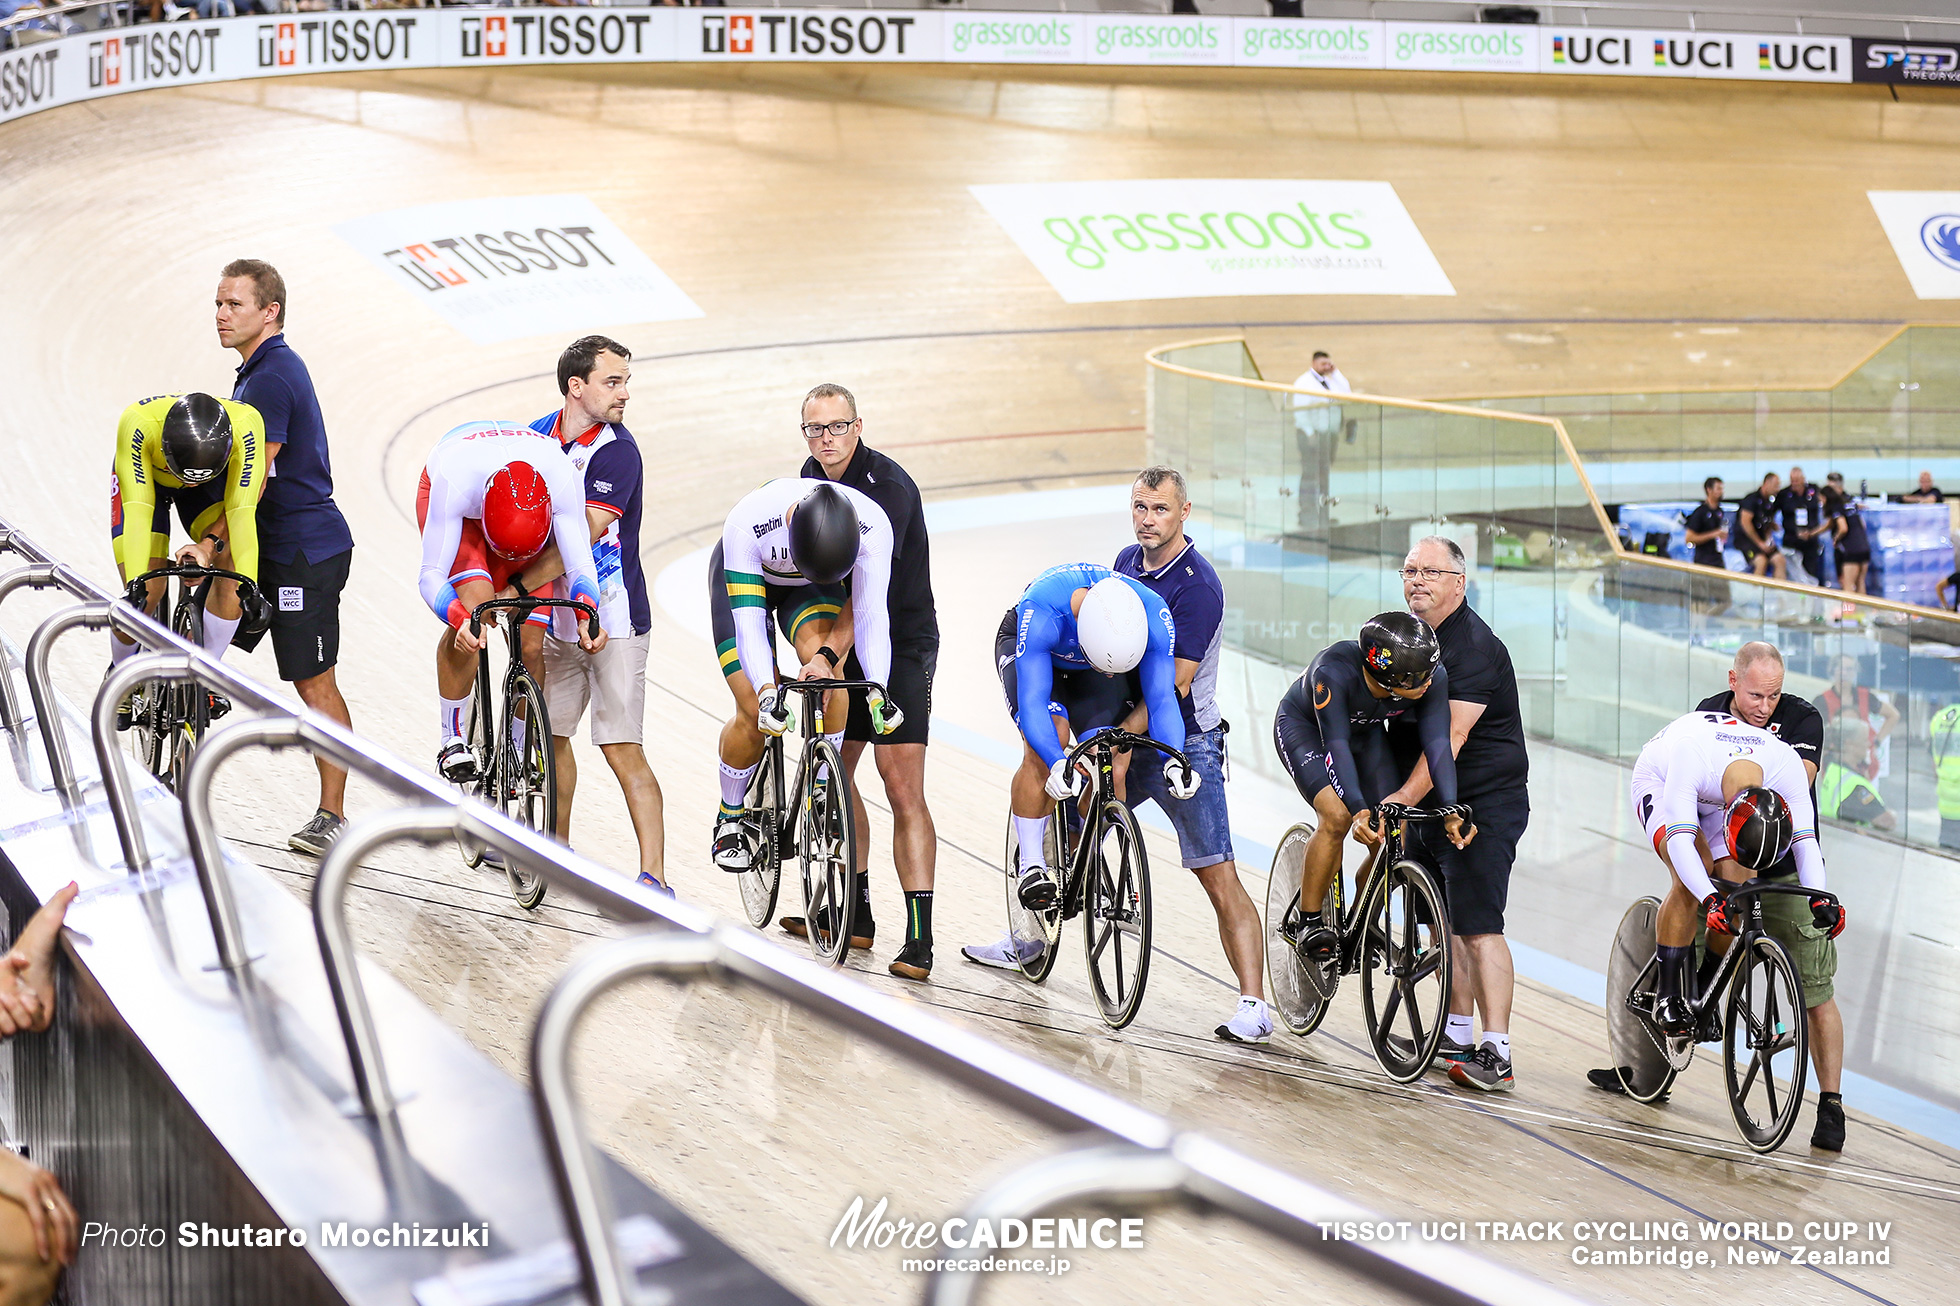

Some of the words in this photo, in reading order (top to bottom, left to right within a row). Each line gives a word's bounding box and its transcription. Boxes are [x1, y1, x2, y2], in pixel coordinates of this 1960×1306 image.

[301, 18, 416, 64] TISSOT
[513, 15, 650, 55] TISSOT
[760, 16, 914, 54] TISSOT
[953, 18, 1071, 53] grassroots
[1096, 22, 1218, 55] grassroots
[1244, 25, 1369, 57] grassroots
[1396, 30, 1523, 61] grassroots
[1568, 38, 1631, 66] UCI
[125, 28, 221, 83] TISSOT
[1669, 41, 1734, 69] UCI
[1773, 44, 1838, 72] UCI
[1866, 44, 1958, 72] SPEED
[1043, 202, 1373, 269] grassroots
[432, 227, 615, 280] TISSOT
[131, 428, 146, 485] THAILAND
[240, 431, 256, 487] THAILAND
[752, 514, 783, 539] Santini
[1328, 769, 1345, 799] CIMB
